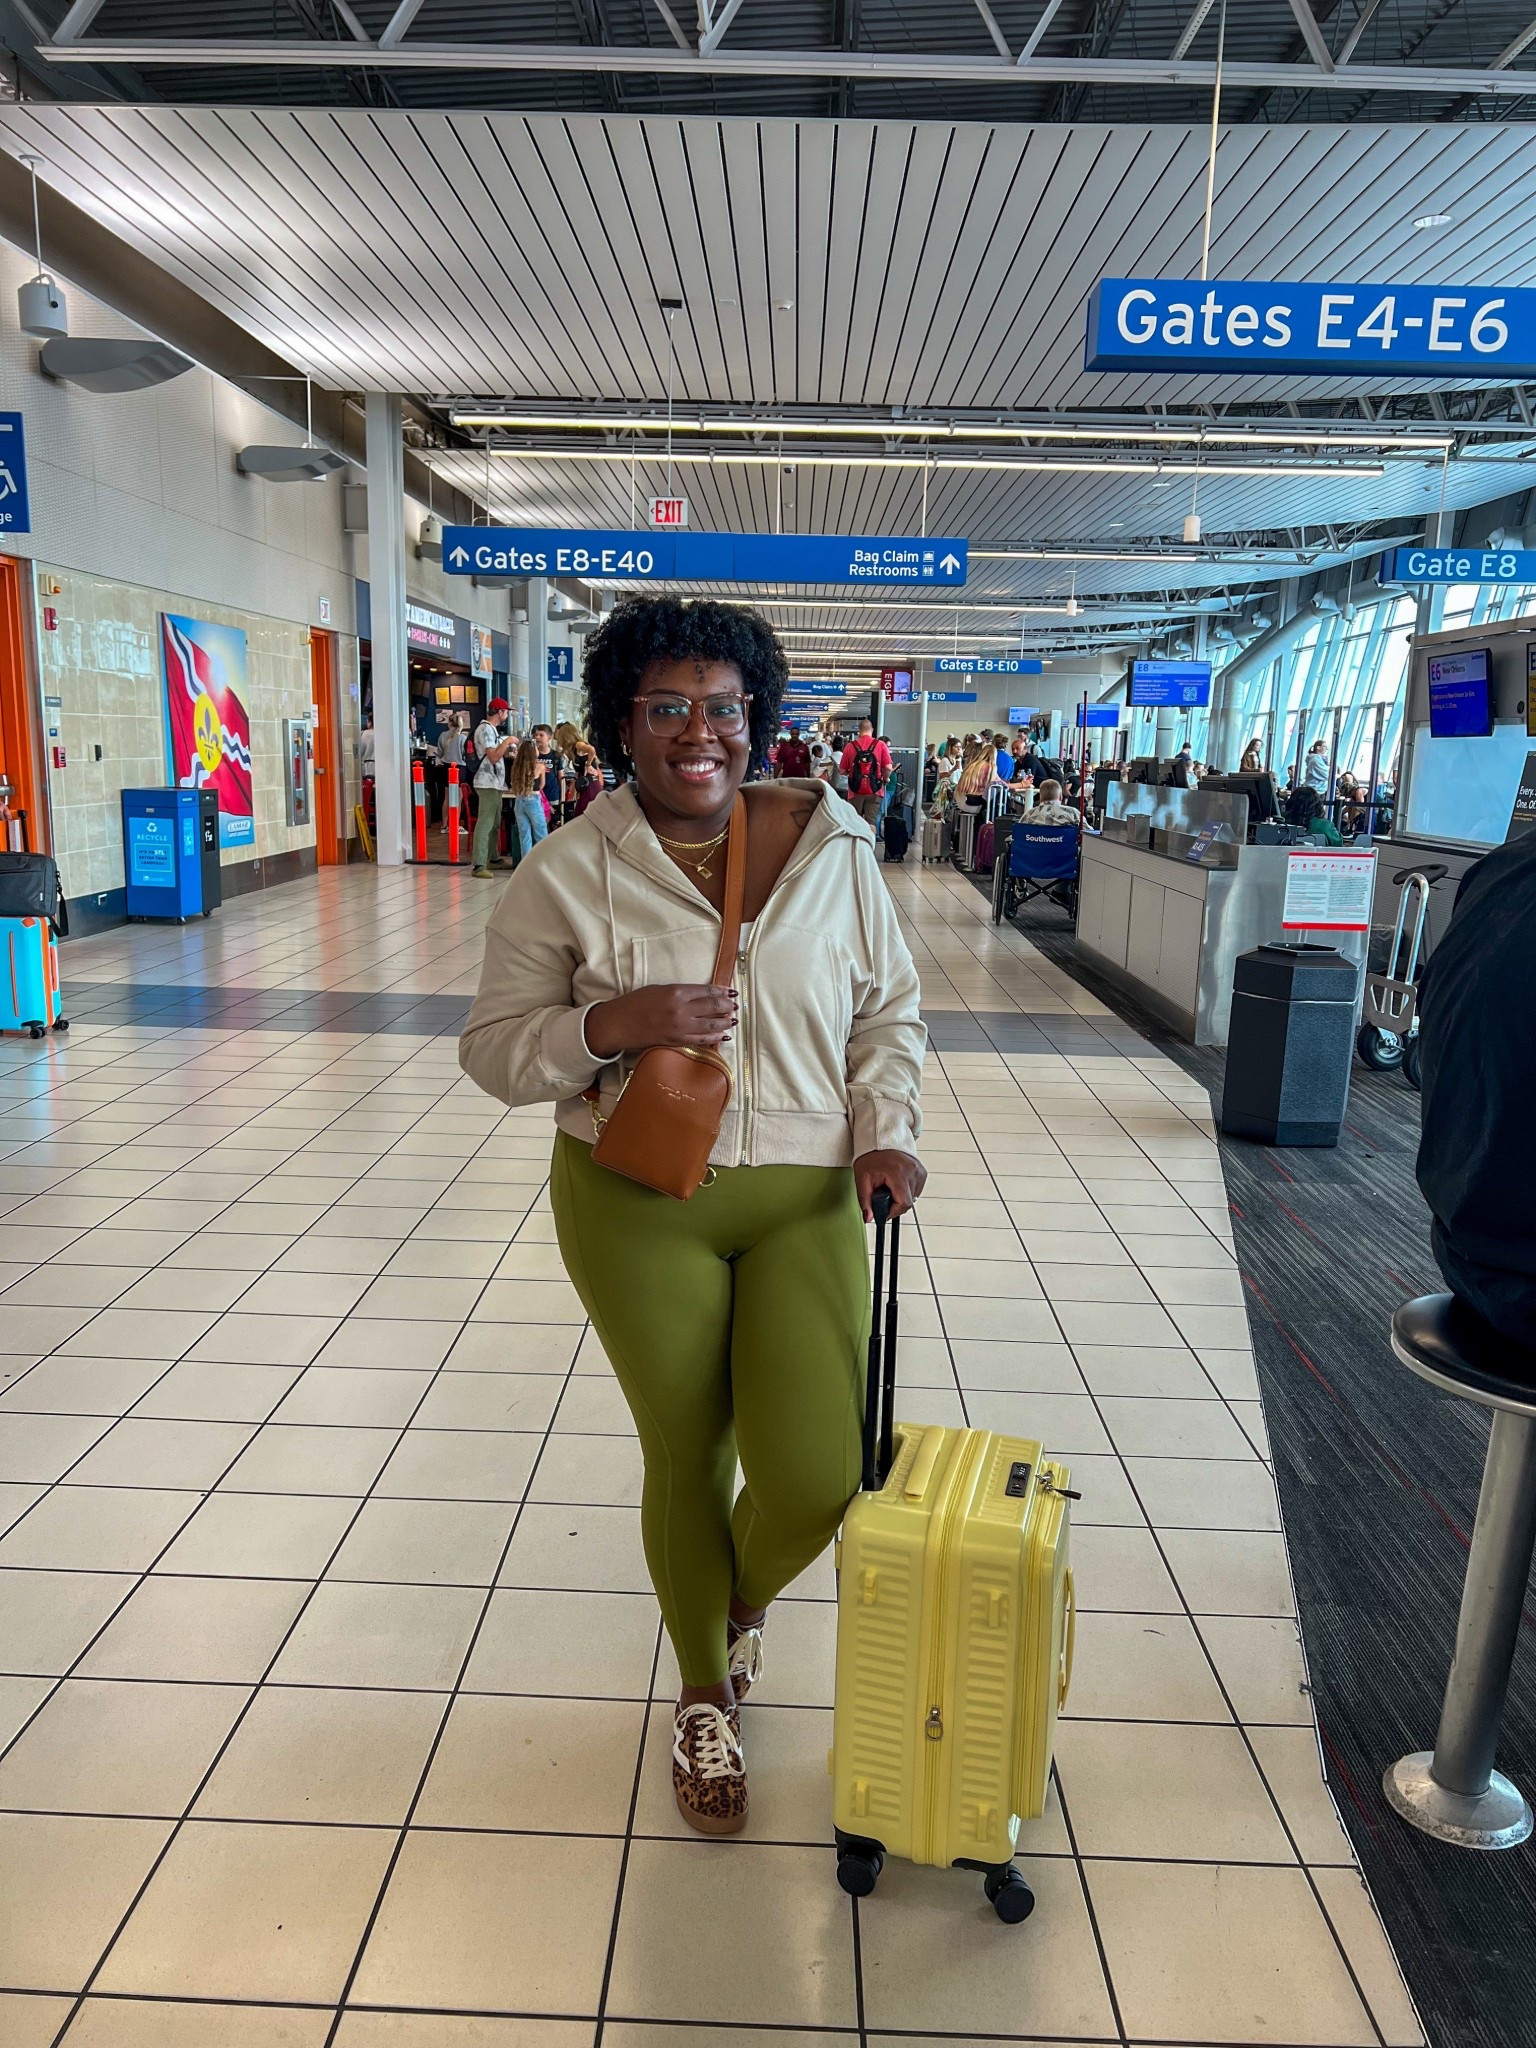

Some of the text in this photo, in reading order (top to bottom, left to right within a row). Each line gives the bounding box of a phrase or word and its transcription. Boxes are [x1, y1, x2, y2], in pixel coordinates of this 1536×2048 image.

[1116, 288, 1510, 353] Gates E4-E6
[654, 499, 684, 523] EXIT
[474, 545, 654, 574] Gates E8-E40
[854, 549, 919, 565] Bag Claim
[849, 564, 919, 577] Restrooms
[1408, 552, 1517, 578] Gate E8
[939, 658, 1019, 672] Gates E8-E10
[1137, 663, 1150, 673] E8
[1431, 663, 1442, 681] E6
[931, 692, 946, 701] E10
[136, 833, 168, 842] RECYCLE
[1025, 833, 1064, 843] Southwest
